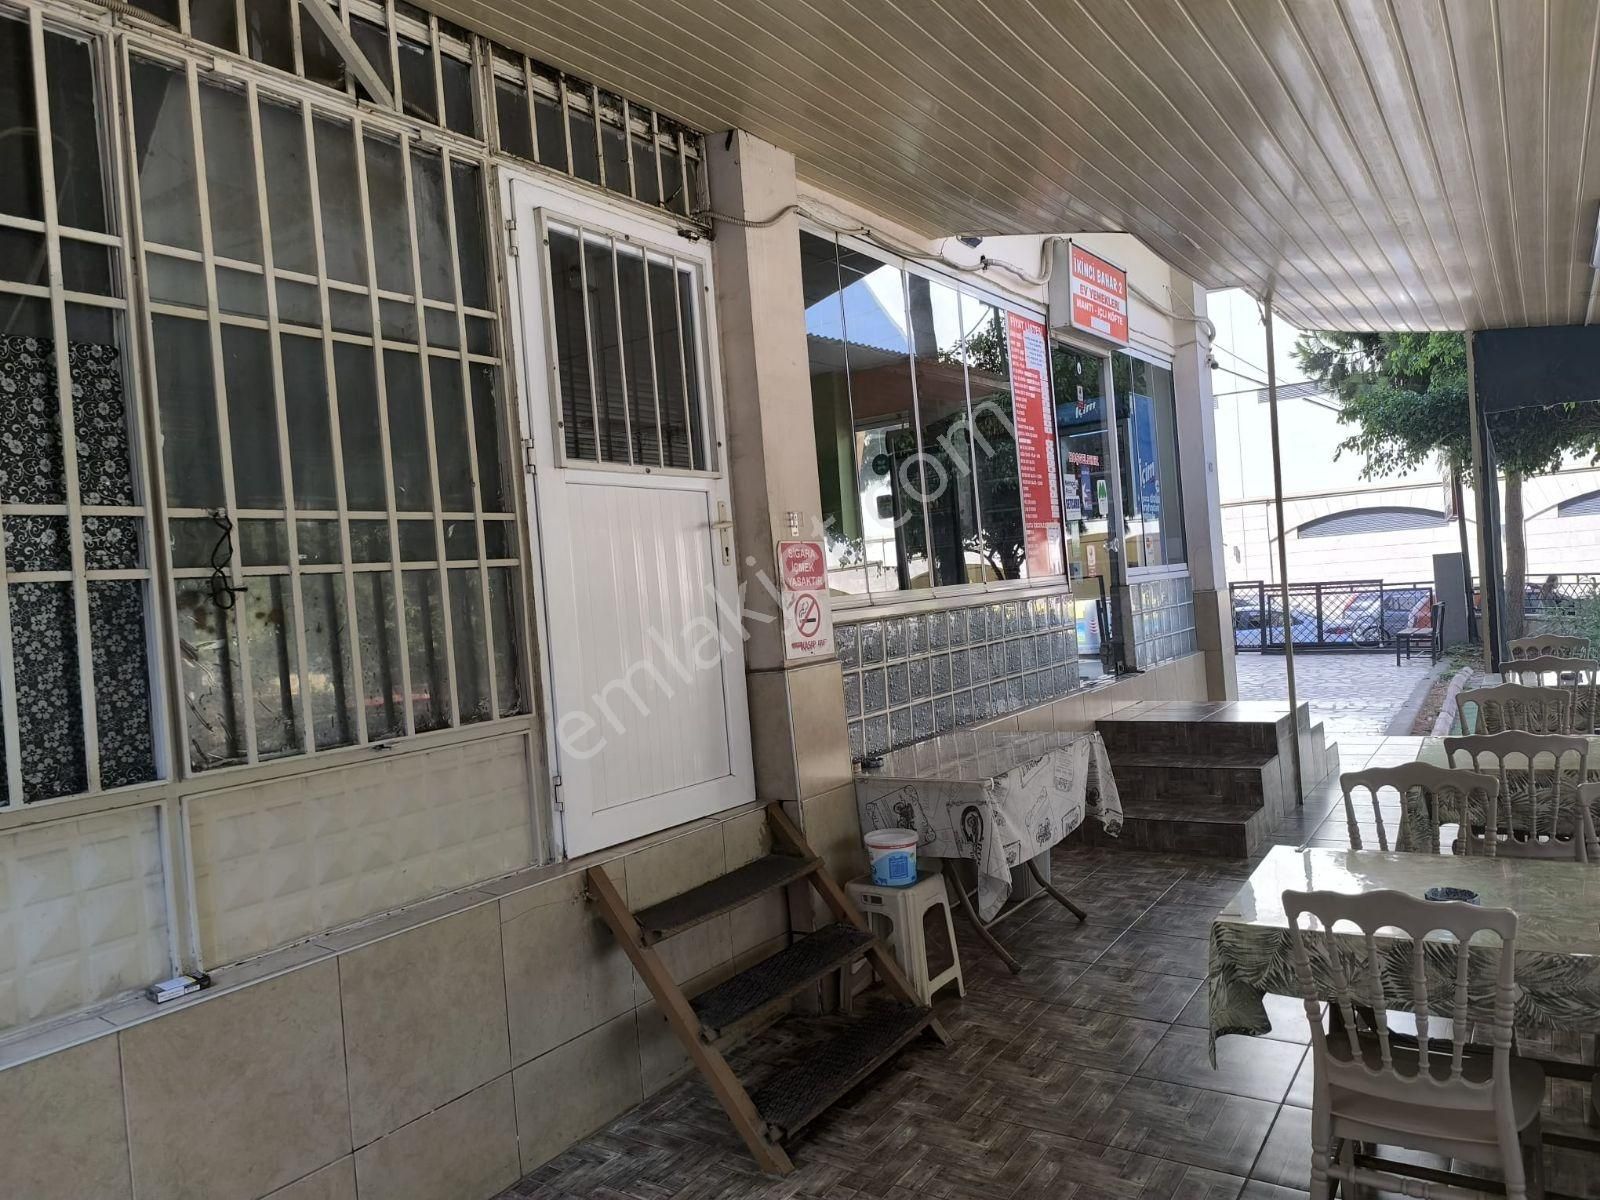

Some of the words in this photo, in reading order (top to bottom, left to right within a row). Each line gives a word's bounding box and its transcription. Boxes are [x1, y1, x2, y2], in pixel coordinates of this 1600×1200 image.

[1096, 269, 1118, 293] BAHAR
[1118, 282, 1123, 295] 2
[1079, 283, 1089, 297] EV
[787, 547, 816, 559] SİGARA
[787, 576, 824, 588] YASAKTIR
